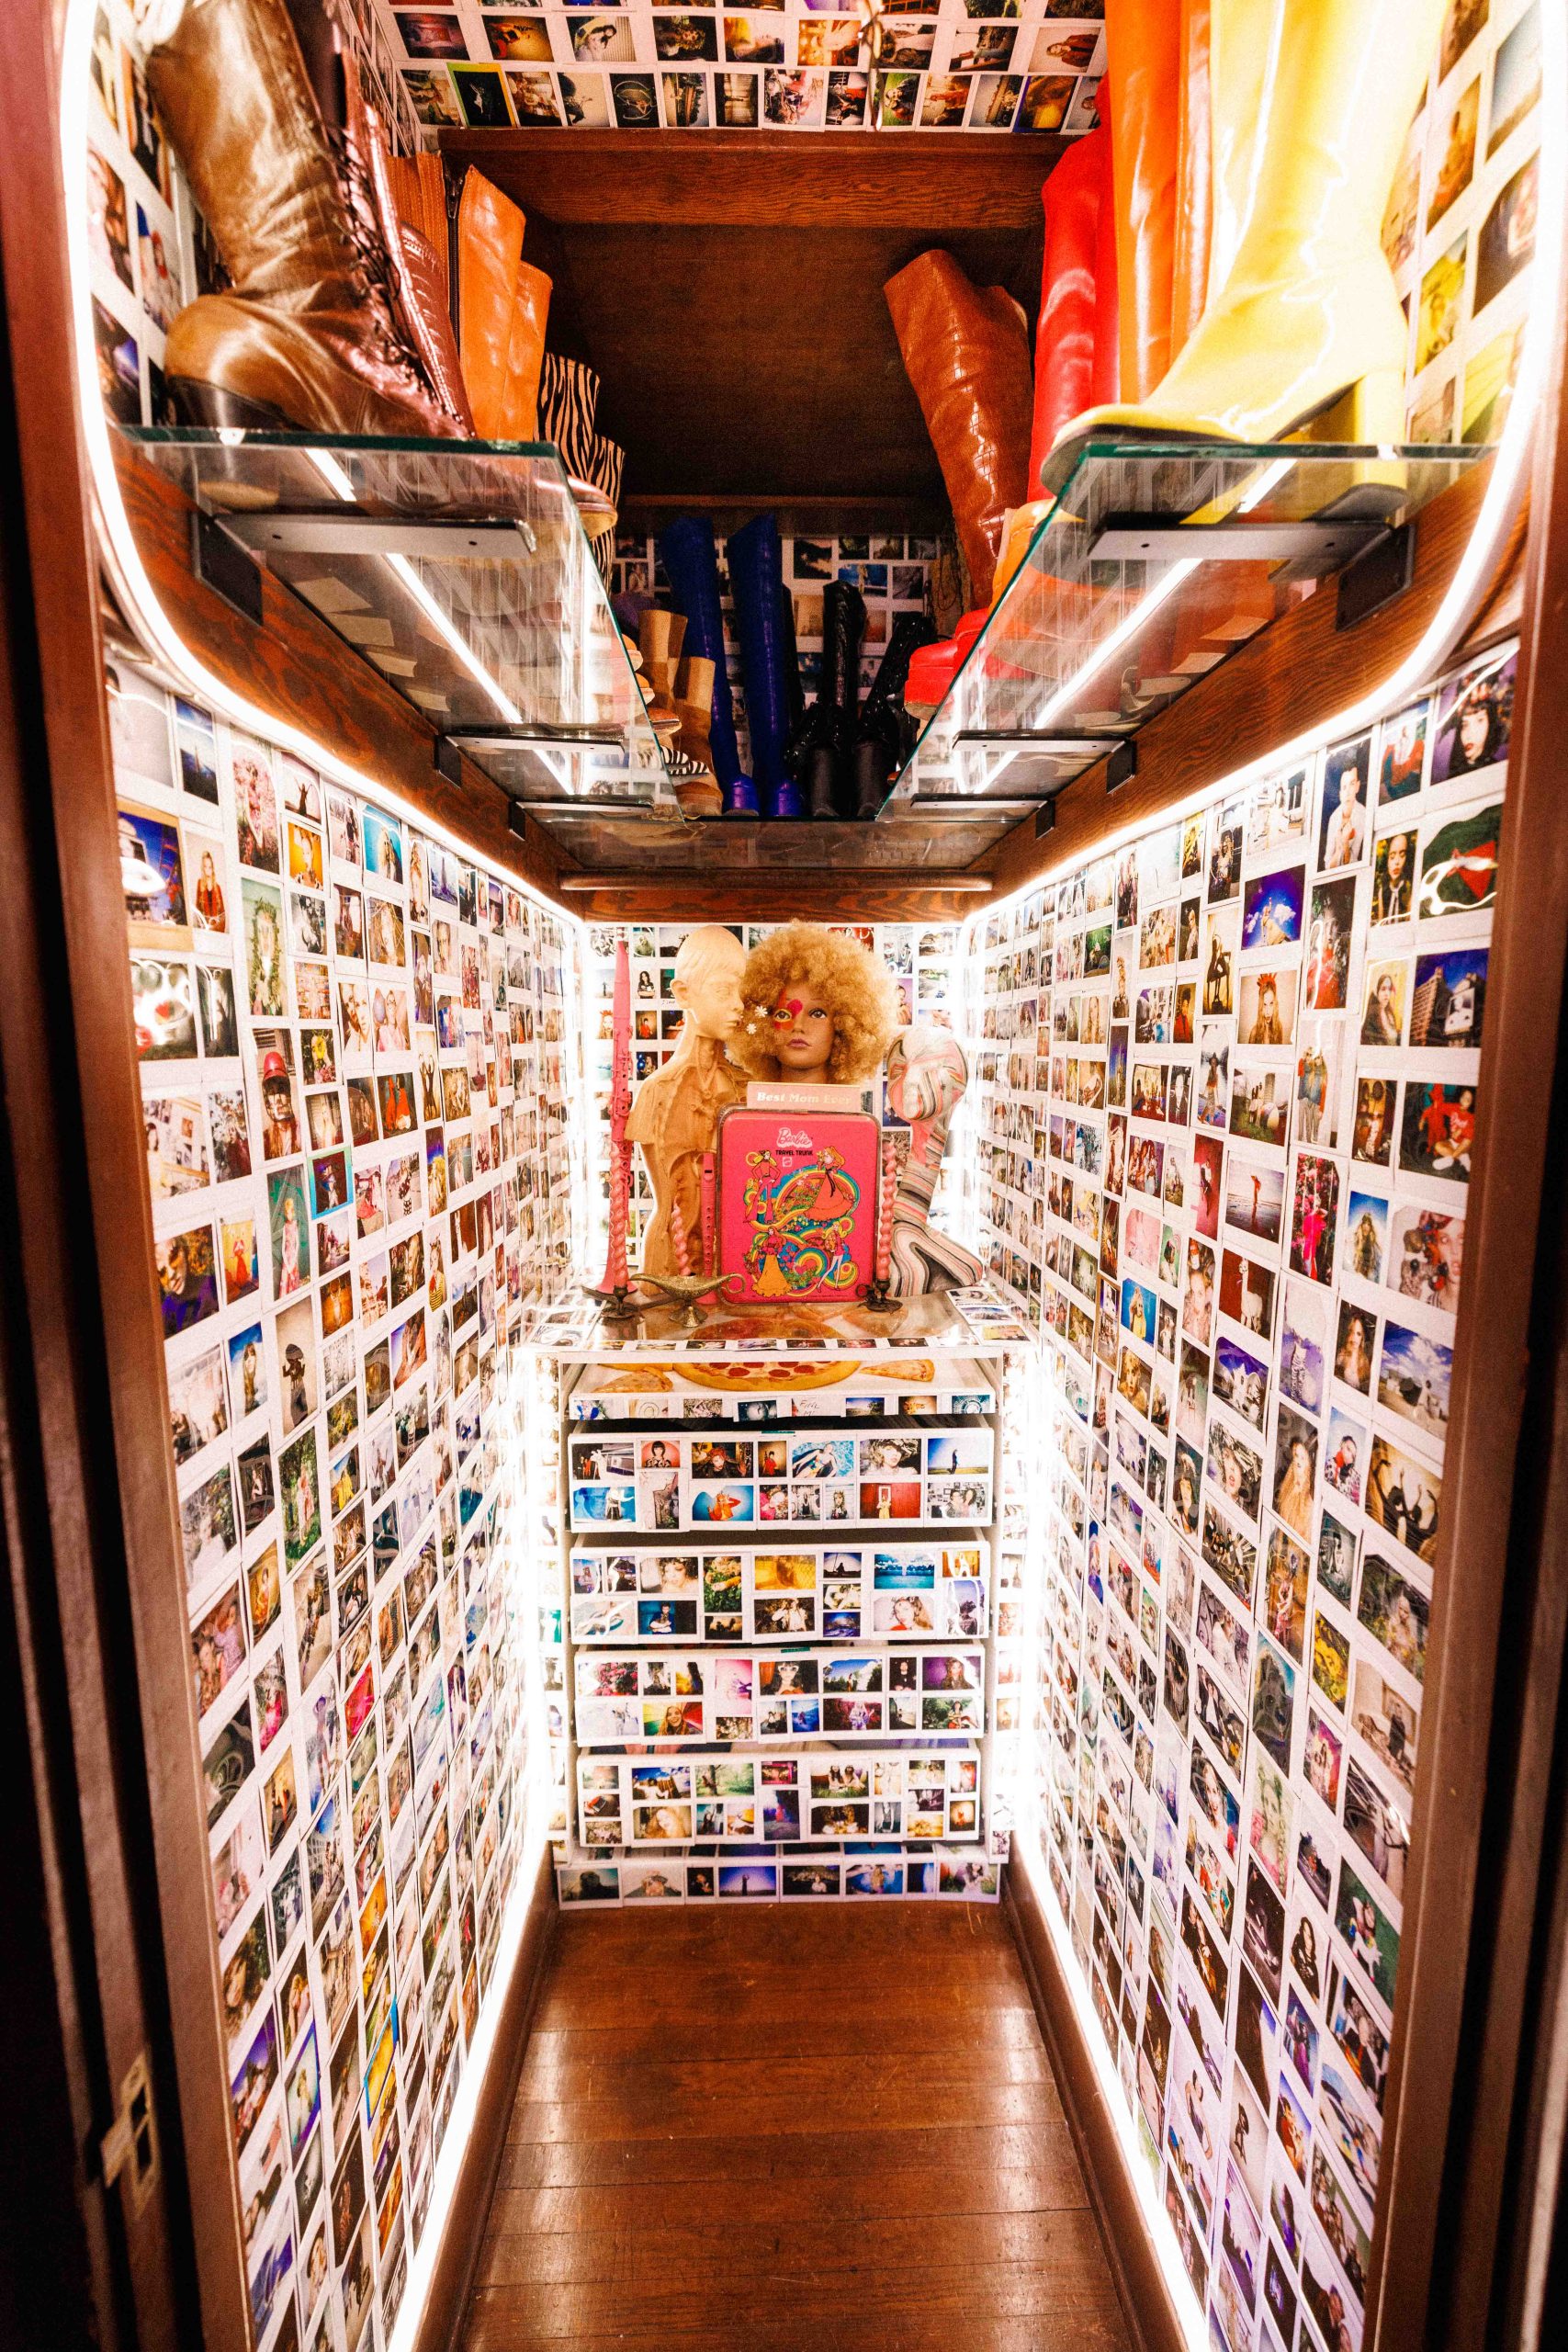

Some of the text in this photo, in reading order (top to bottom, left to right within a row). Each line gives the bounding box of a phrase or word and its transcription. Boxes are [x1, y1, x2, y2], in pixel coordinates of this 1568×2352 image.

[757, 1091, 852, 1104] Best Mom Ever
[778, 1127, 812, 1147] Barbie
